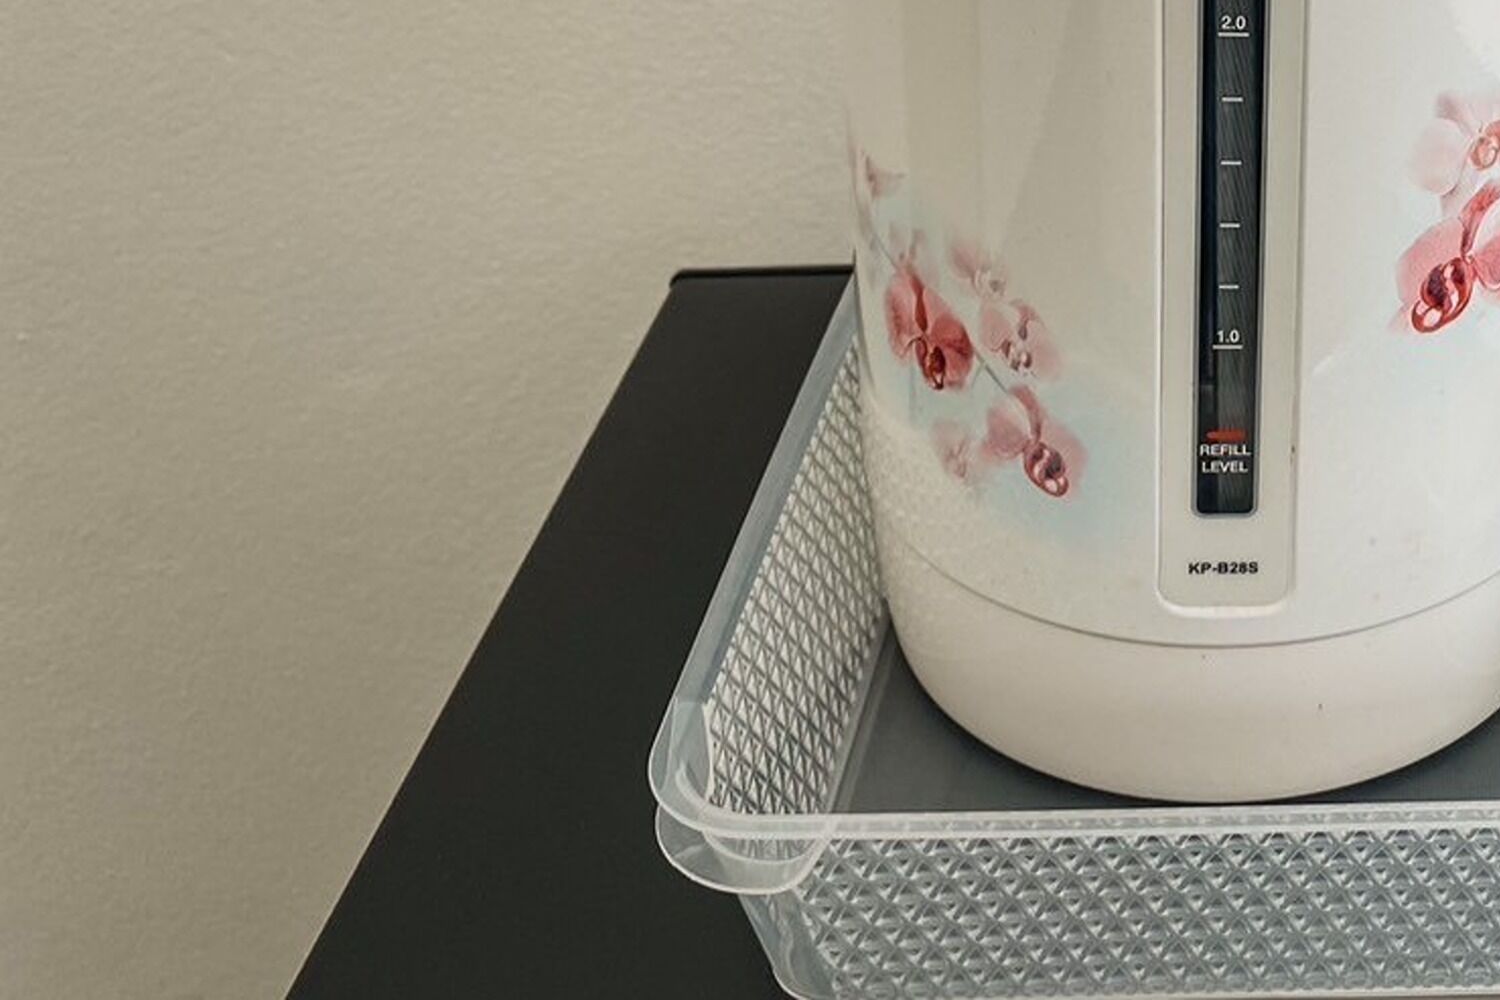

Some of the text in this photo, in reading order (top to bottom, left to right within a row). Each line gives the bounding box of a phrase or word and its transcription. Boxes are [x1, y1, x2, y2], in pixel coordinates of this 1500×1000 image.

[1220, 14, 1247, 31] 2.0
[1216, 329, 1241, 344] 1.0
[1199, 443, 1252, 456] REFILL
[1201, 460, 1249, 474] LEVEL
[1188, 561, 1259, 575] KP-B28S
